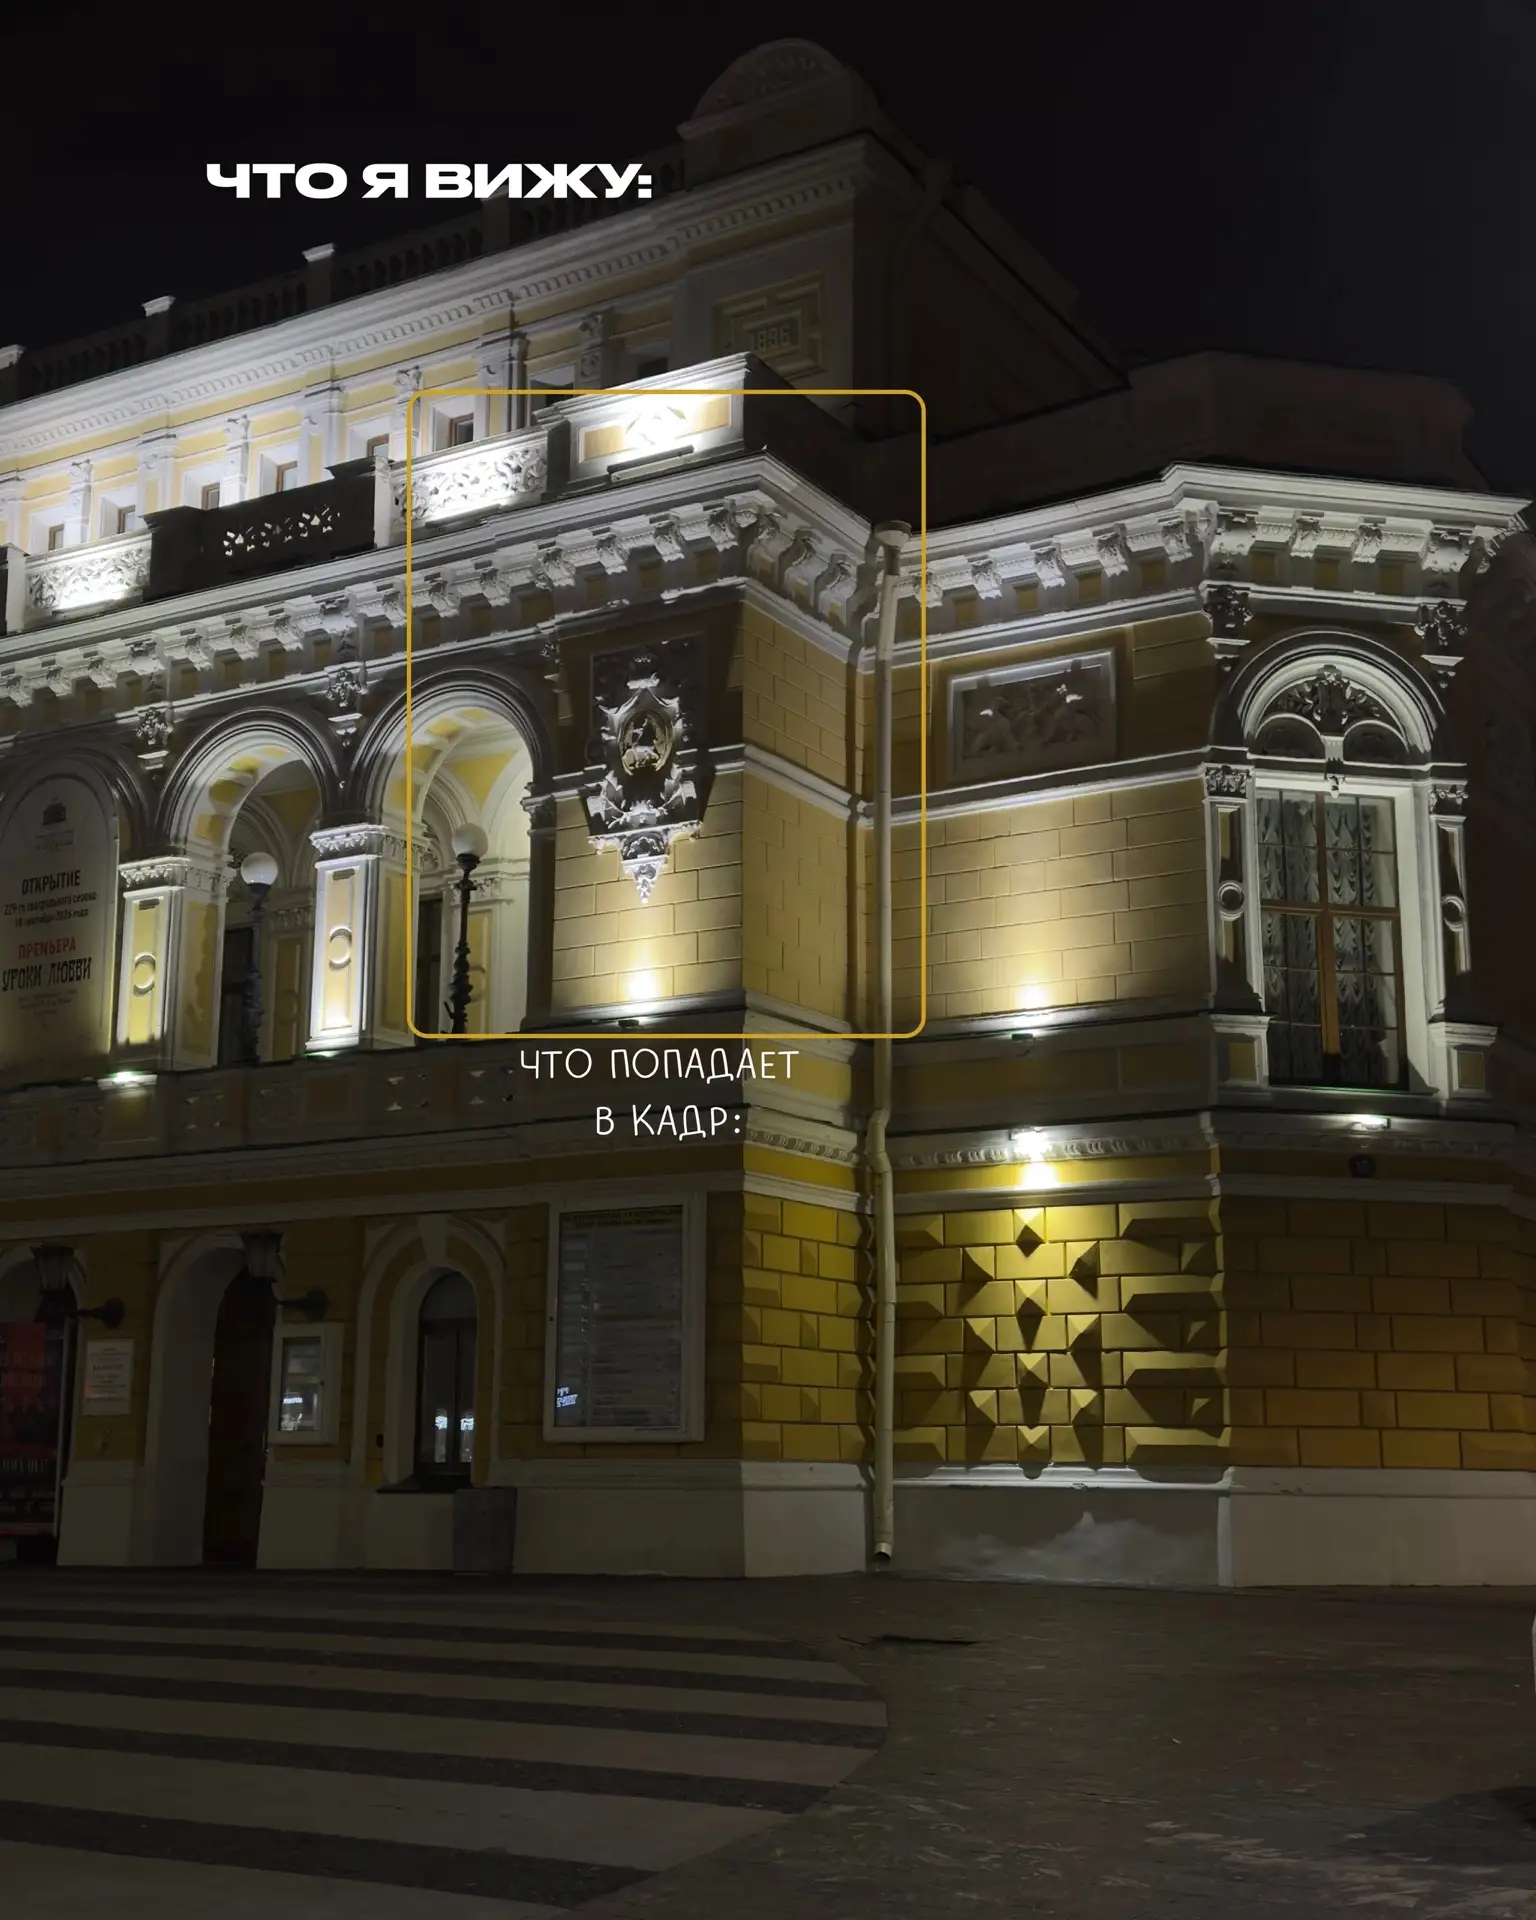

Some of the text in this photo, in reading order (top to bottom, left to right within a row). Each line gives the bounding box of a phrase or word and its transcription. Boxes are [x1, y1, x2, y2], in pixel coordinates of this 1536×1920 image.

[21, 869, 81, 896] ОТКРЫТИЕ
[18, 936, 76, 960] ПРЕМЬЕРА
[2, 956, 92, 992] УРОКИ ЛЮБВИ
